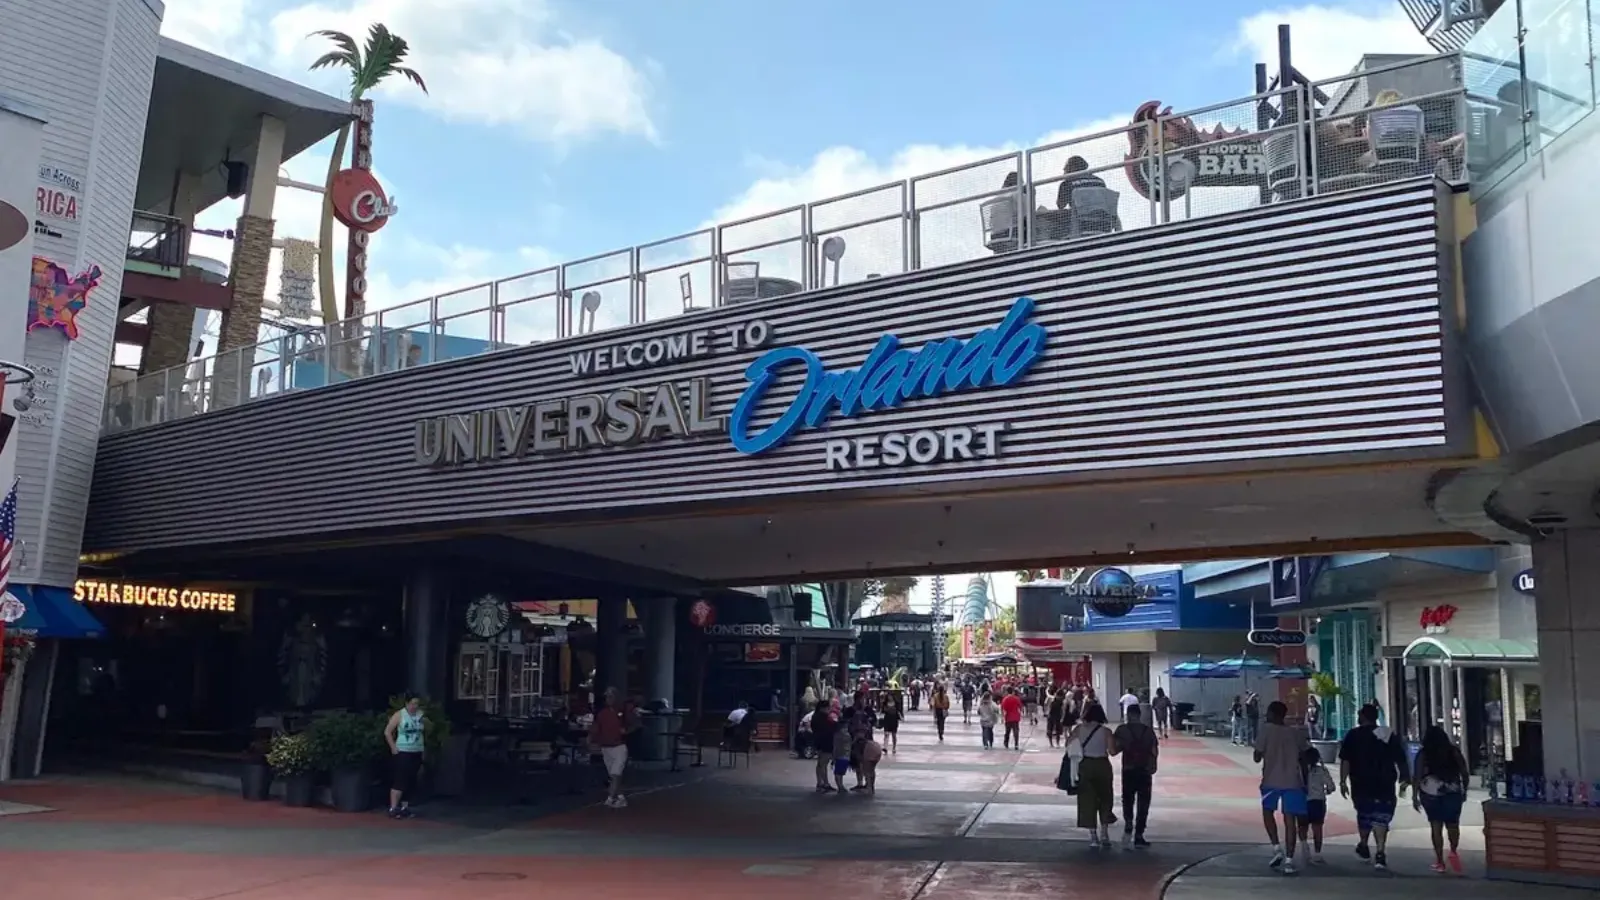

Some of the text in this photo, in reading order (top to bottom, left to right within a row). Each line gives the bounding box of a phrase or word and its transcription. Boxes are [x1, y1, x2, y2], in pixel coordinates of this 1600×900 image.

[1199, 154, 1268, 175] BAR
[352, 189, 398, 222] Club
[569, 319, 773, 376] WELCOME TO
[413, 297, 1048, 467] UNIVERSAL Orlando
[825, 422, 1005, 471] RESORT
[73, 579, 236, 612] STARBUCKS COFFEE
[704, 623, 781, 635] CONCIERGE
